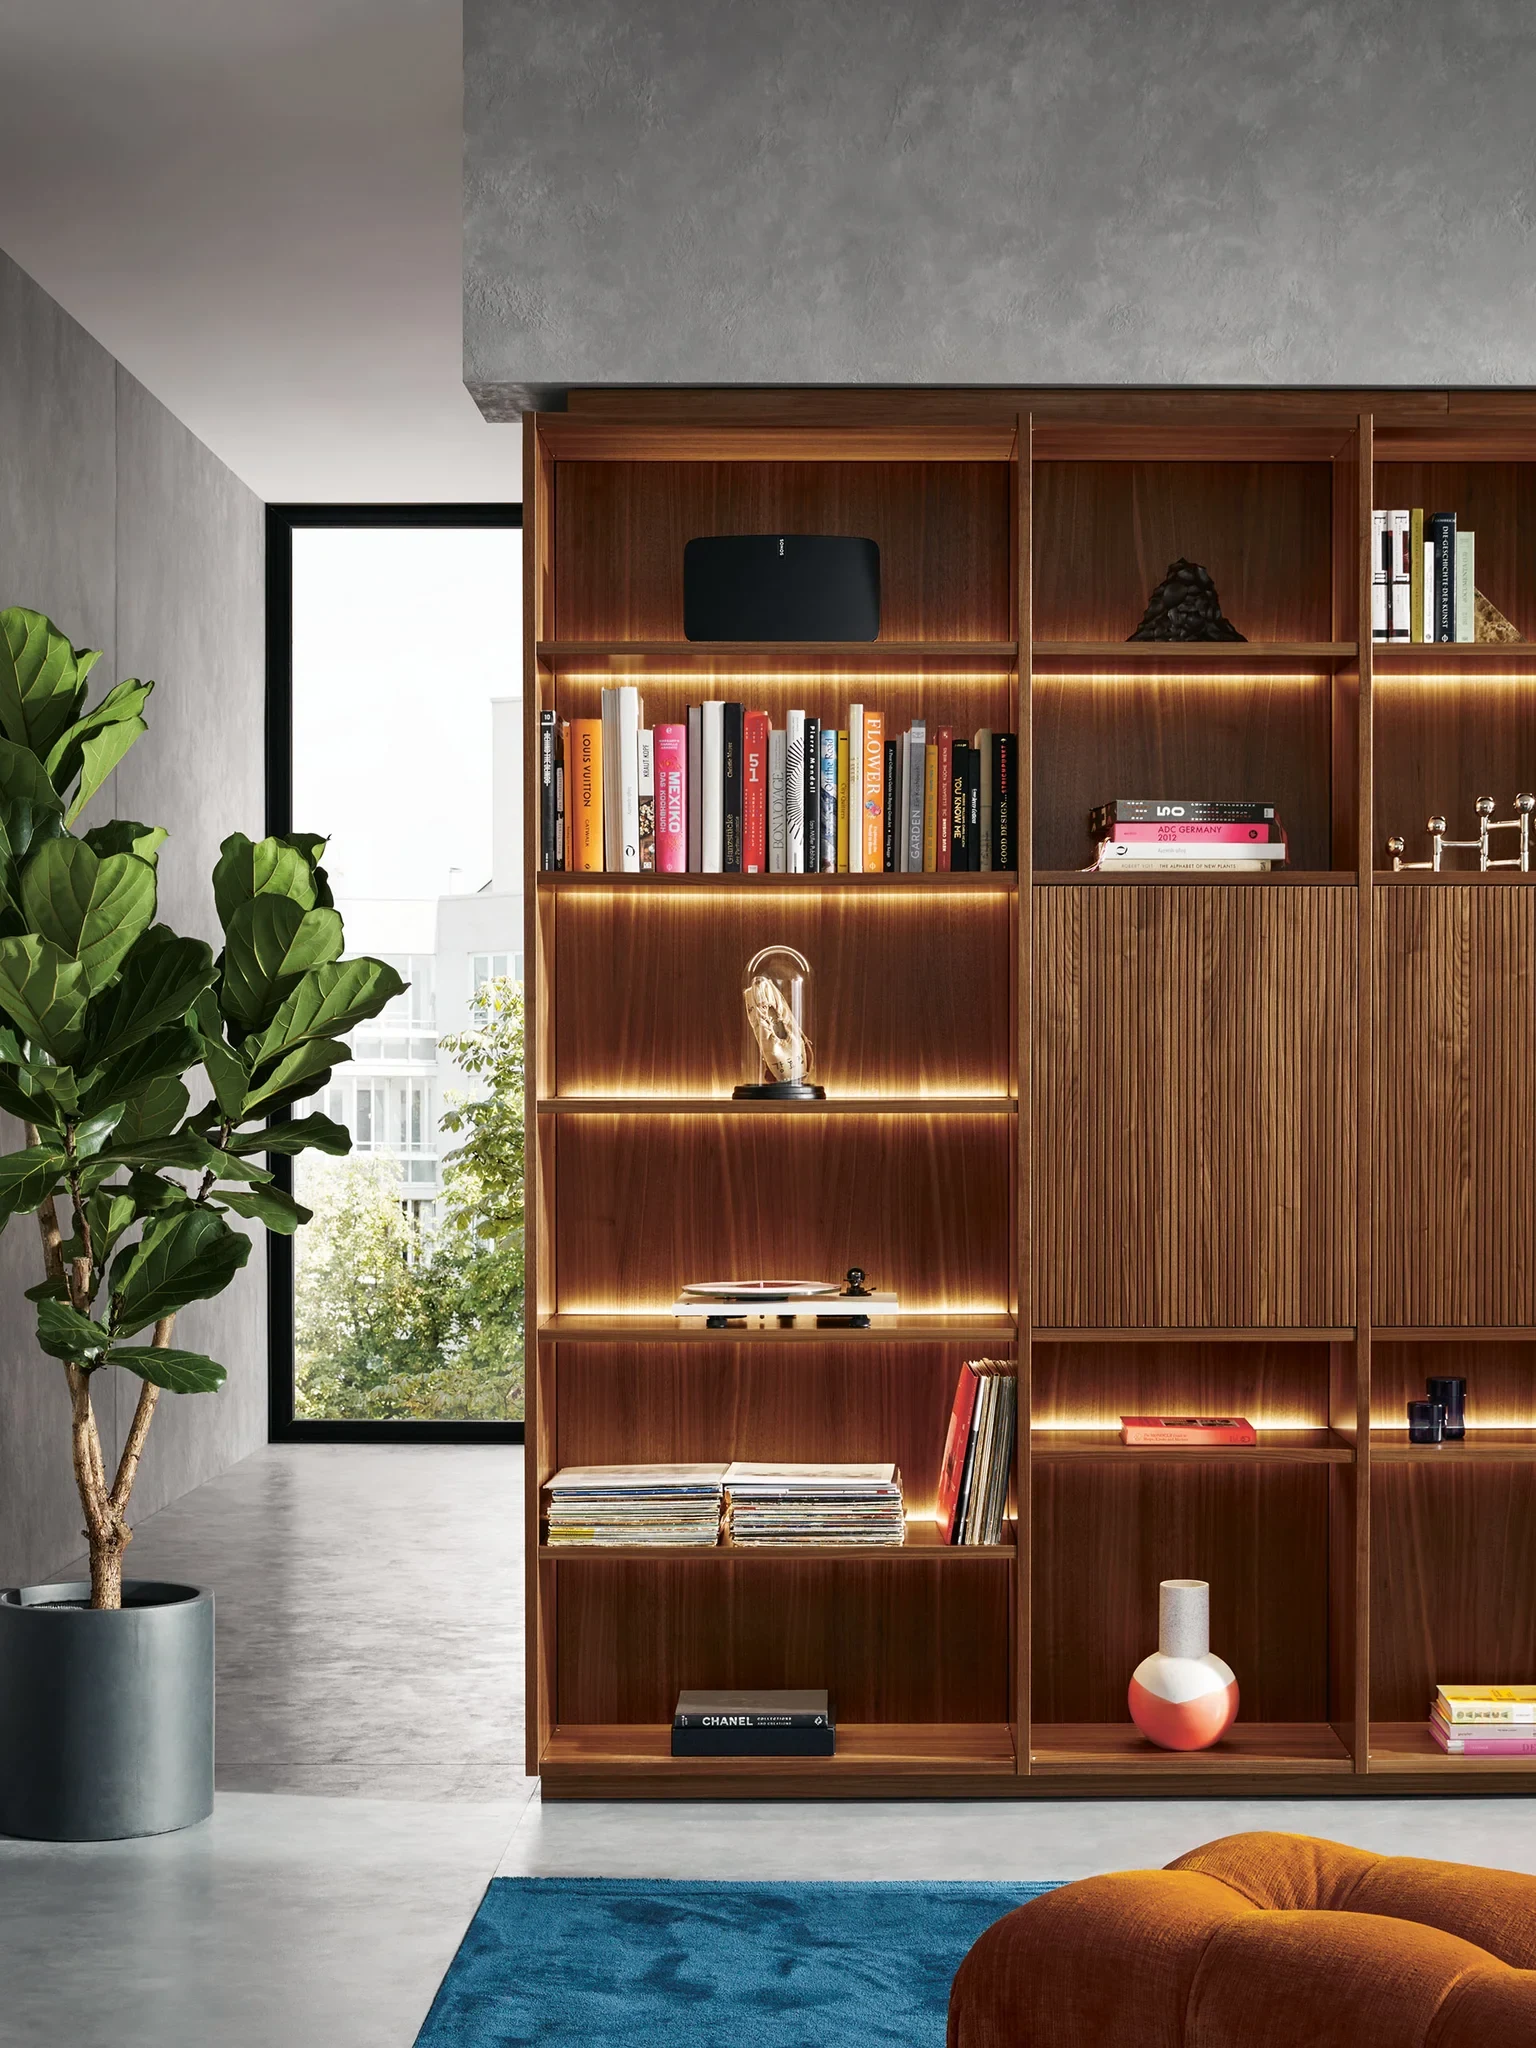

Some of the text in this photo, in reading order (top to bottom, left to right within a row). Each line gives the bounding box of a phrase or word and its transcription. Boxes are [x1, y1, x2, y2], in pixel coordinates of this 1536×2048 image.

[583, 734, 592, 807] LOUIS VUITTON
[825, 739, 834, 760] Road
[825, 763, 834, 777] the
[867, 719, 881, 795] FLOWER
[668, 772, 681, 833] MEXIKO
[773, 772, 785, 822] VOYAGE
[954, 777, 963, 838] YOU KNOW ME
[911, 810, 921, 859] GARDEN
[1158, 826, 1222, 834] ADC GERMANY
[1158, 834, 1177, 842] 2012
[702, 1717, 753, 1726] CHANEL
